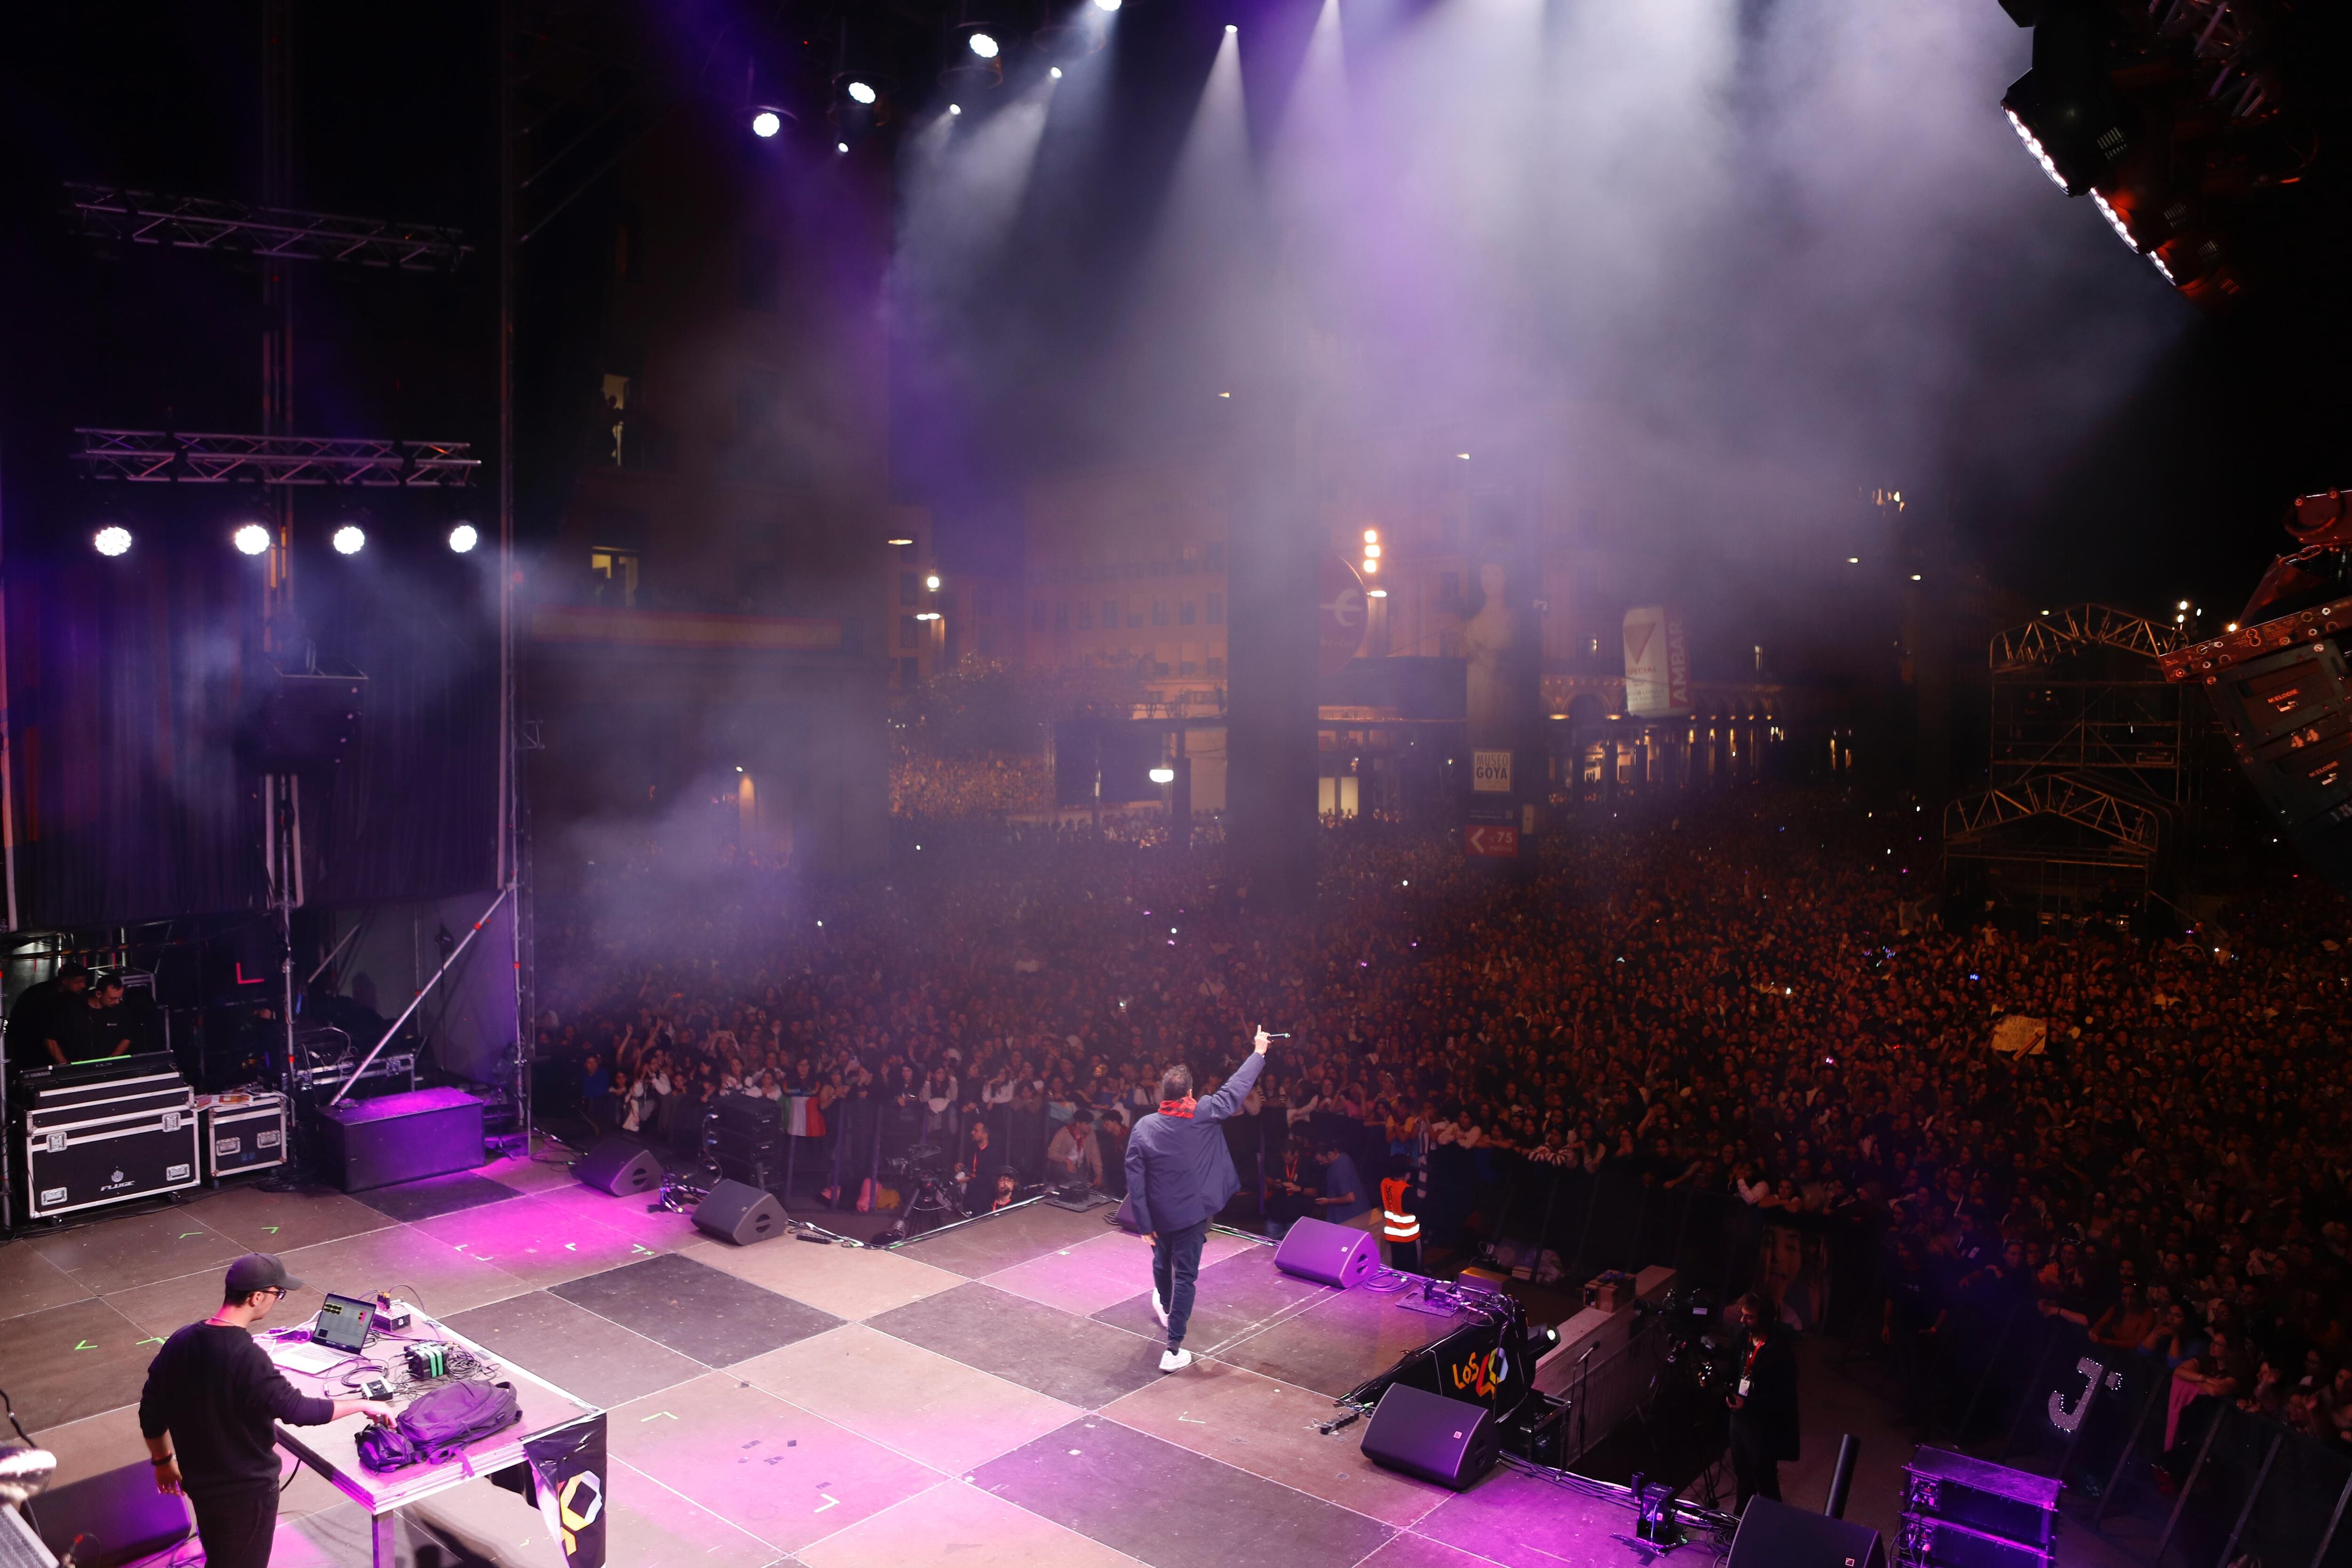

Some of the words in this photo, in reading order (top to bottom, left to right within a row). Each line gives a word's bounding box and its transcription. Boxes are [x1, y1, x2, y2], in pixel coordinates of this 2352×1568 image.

[1670, 620, 1688, 702] AMBAR
[1477, 754, 1508, 766] MUSEO
[1476, 766, 1507, 779] GOYA
[1497, 831, 1513, 844] 75
